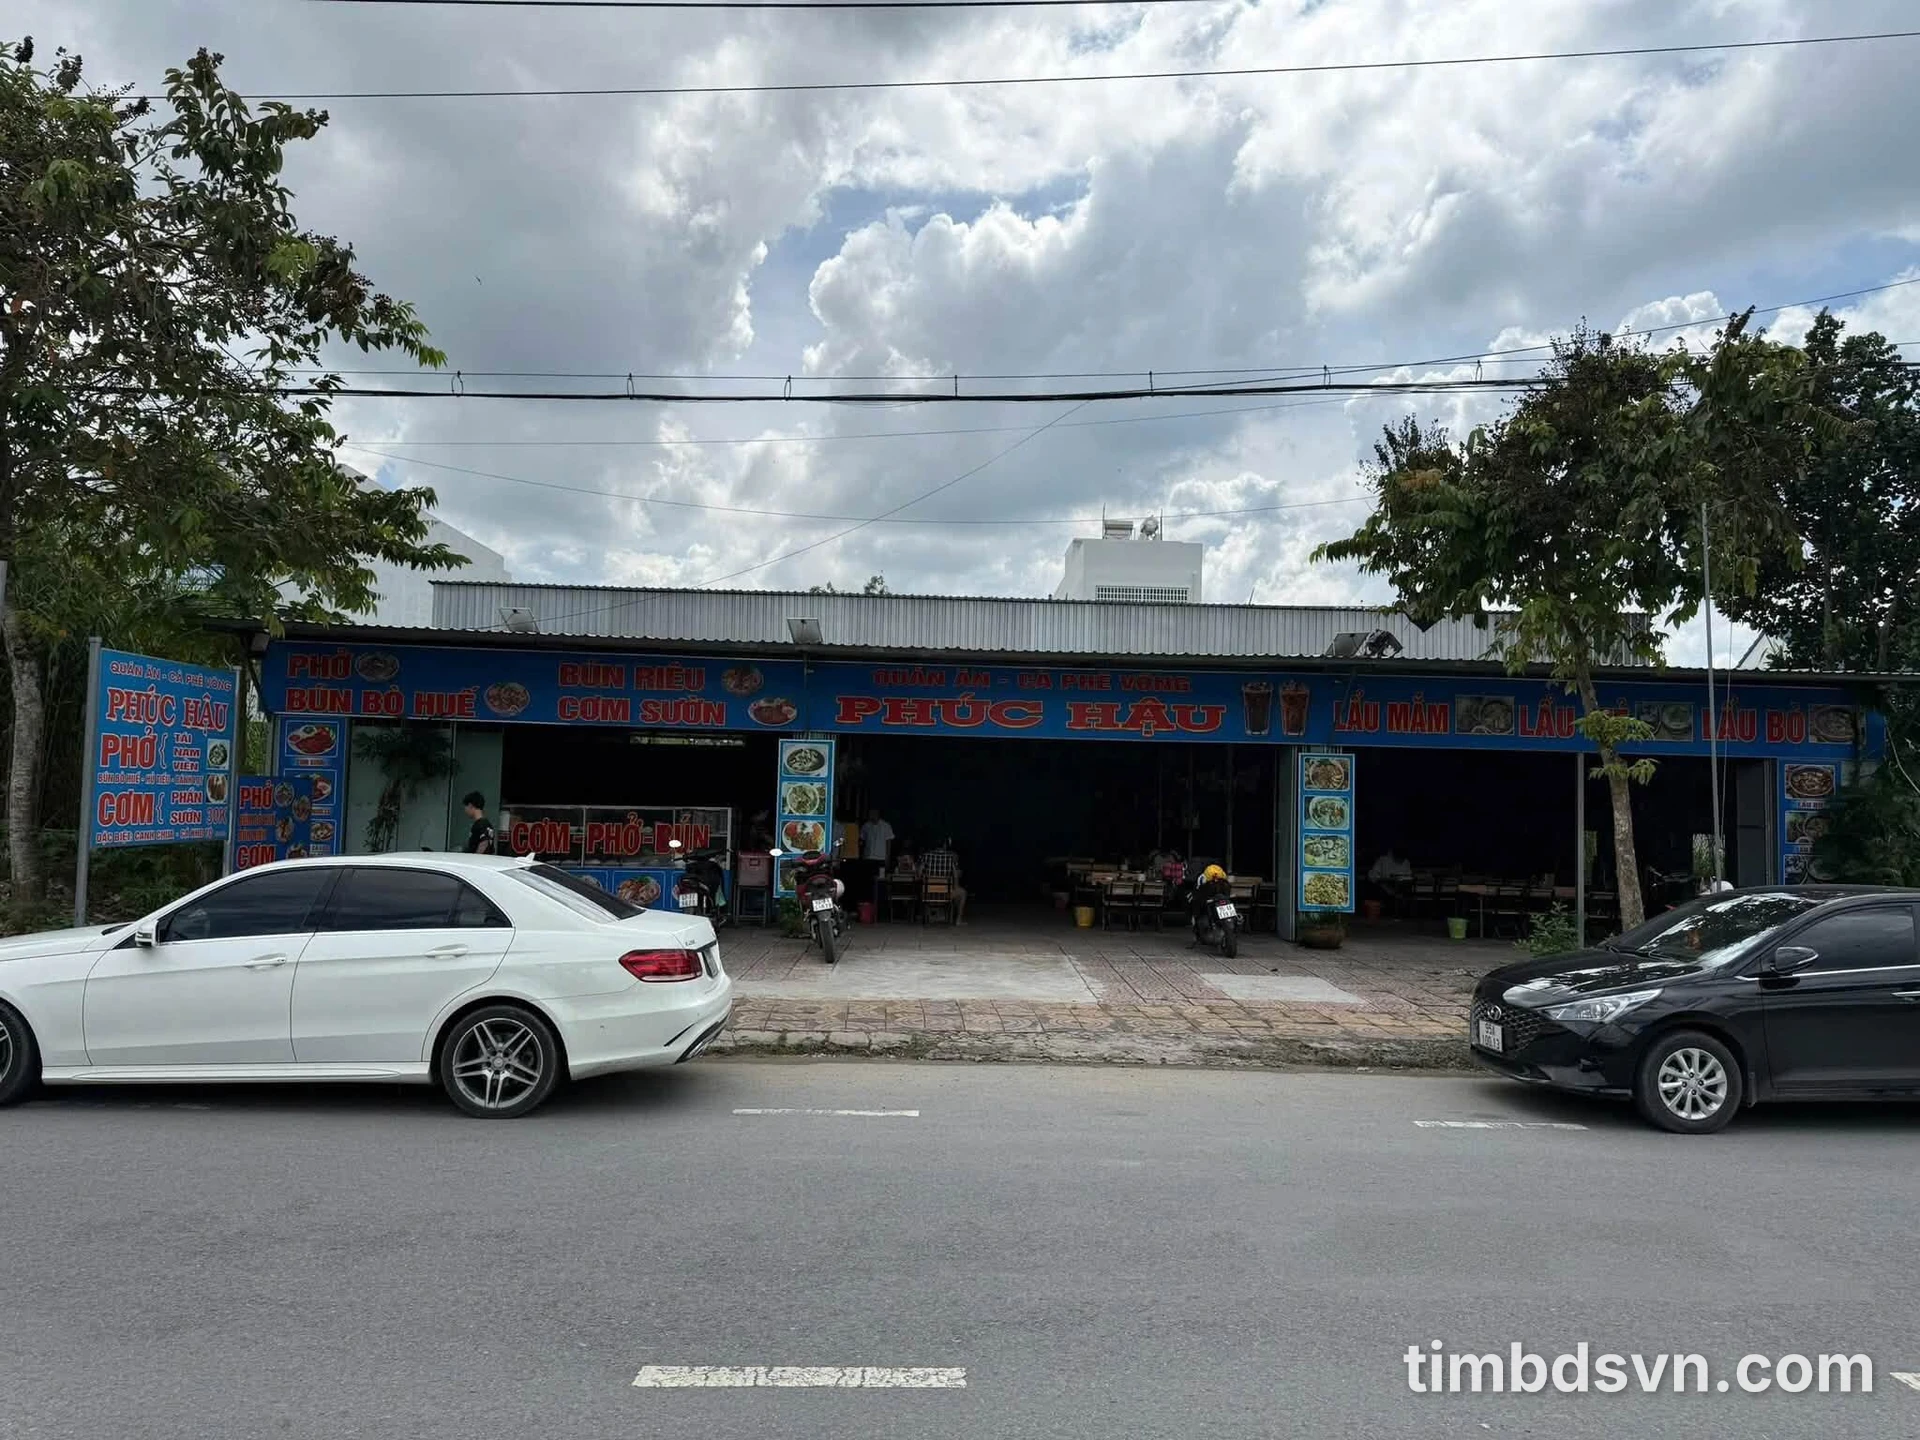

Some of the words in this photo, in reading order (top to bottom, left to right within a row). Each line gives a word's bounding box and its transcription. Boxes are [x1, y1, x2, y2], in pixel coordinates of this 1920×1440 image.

[286, 646, 353, 680] PHỞ
[557, 660, 625, 690] BÚN
[633, 661, 706, 691] RIÊU
[106, 684, 176, 727] PHÚC
[183, 692, 230, 737] HẬU
[285, 683, 353, 713] BÚN
[360, 685, 404, 715] BÒ
[413, 685, 480, 718] HUẾ
[557, 695, 631, 723] CƠM
[639, 695, 728, 726] SƯỜN
[835, 692, 1044, 728] PHÚC
[1066, 695, 1227, 737] HẬU
[1386, 690, 1450, 735] MẮM
[100, 725, 158, 770] PHỞ
[97, 789, 155, 827] CƠM
[511, 817, 571, 854] CƠM
[586, 811, 644, 856] PHỞ
